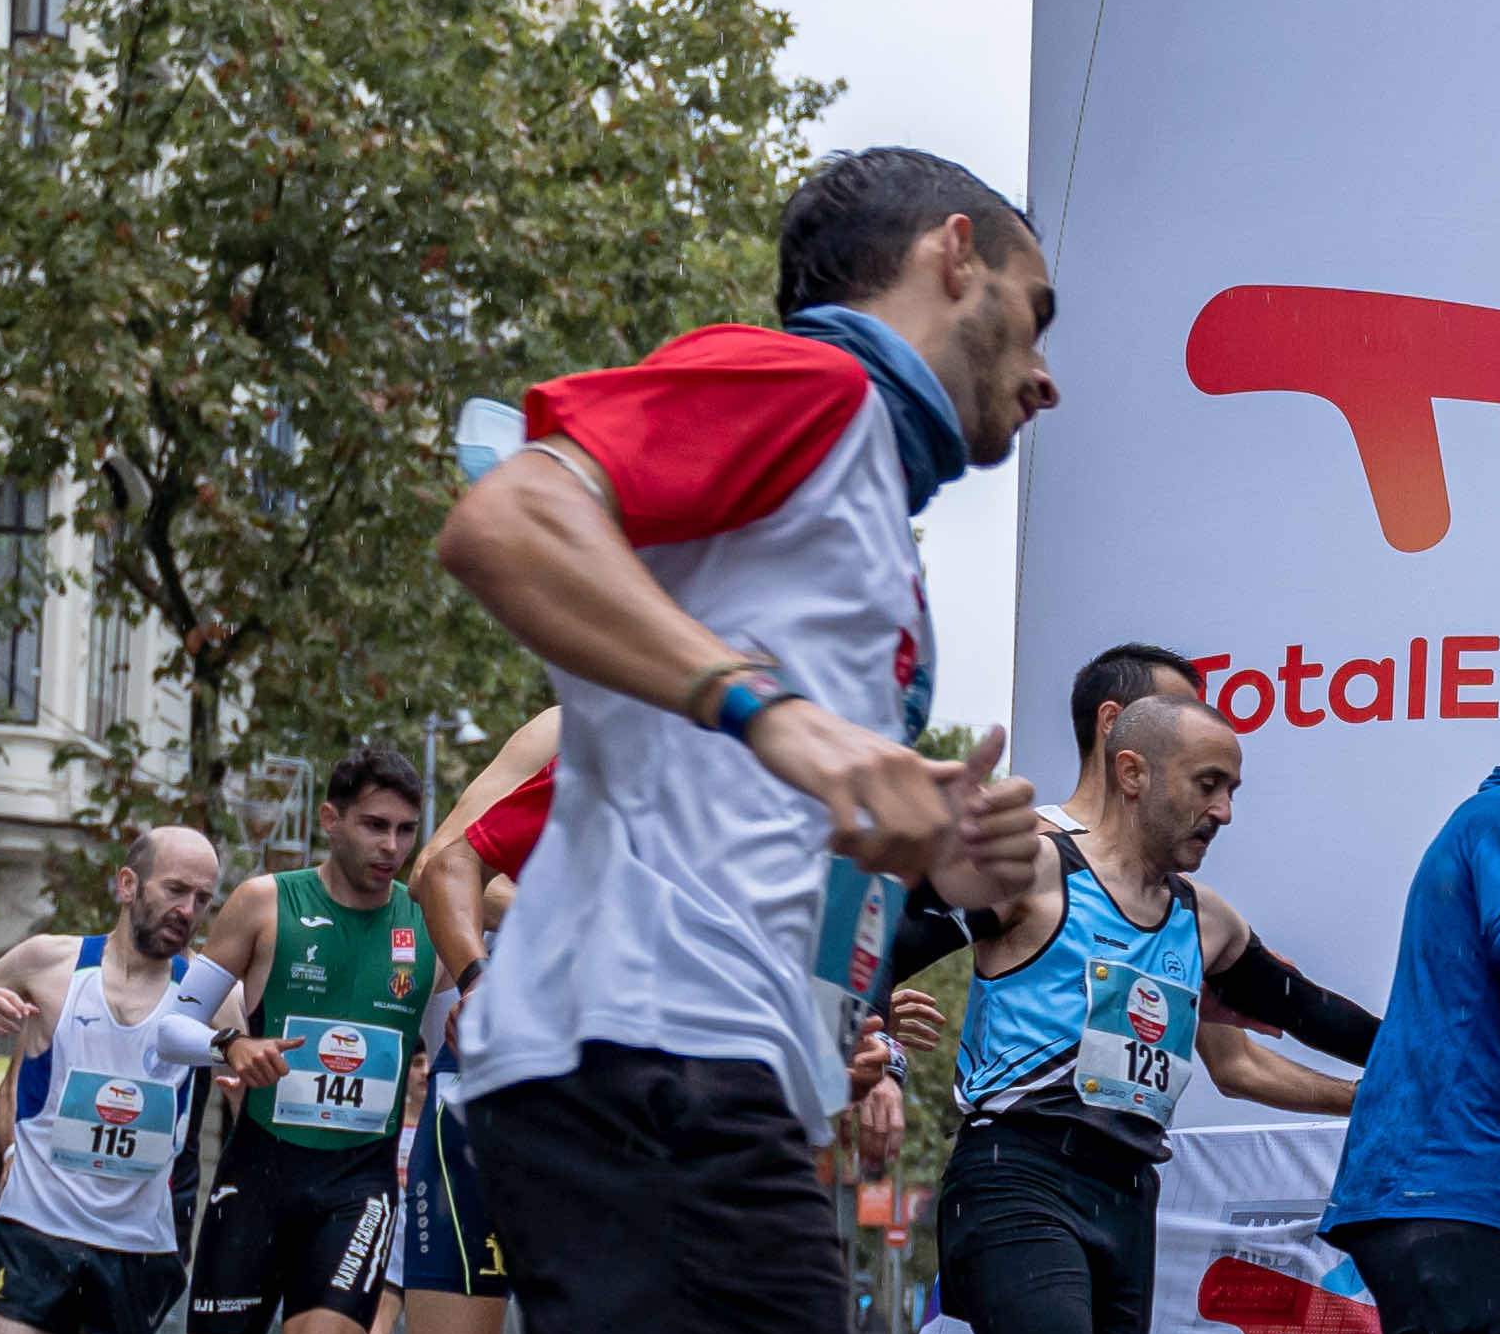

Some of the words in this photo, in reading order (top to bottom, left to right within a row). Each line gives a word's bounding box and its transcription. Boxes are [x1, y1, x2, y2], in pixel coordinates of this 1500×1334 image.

[1124, 1040, 1171, 1093] 123
[313, 1073, 365, 1108] 144
[90, 1125, 137, 1159] 115
